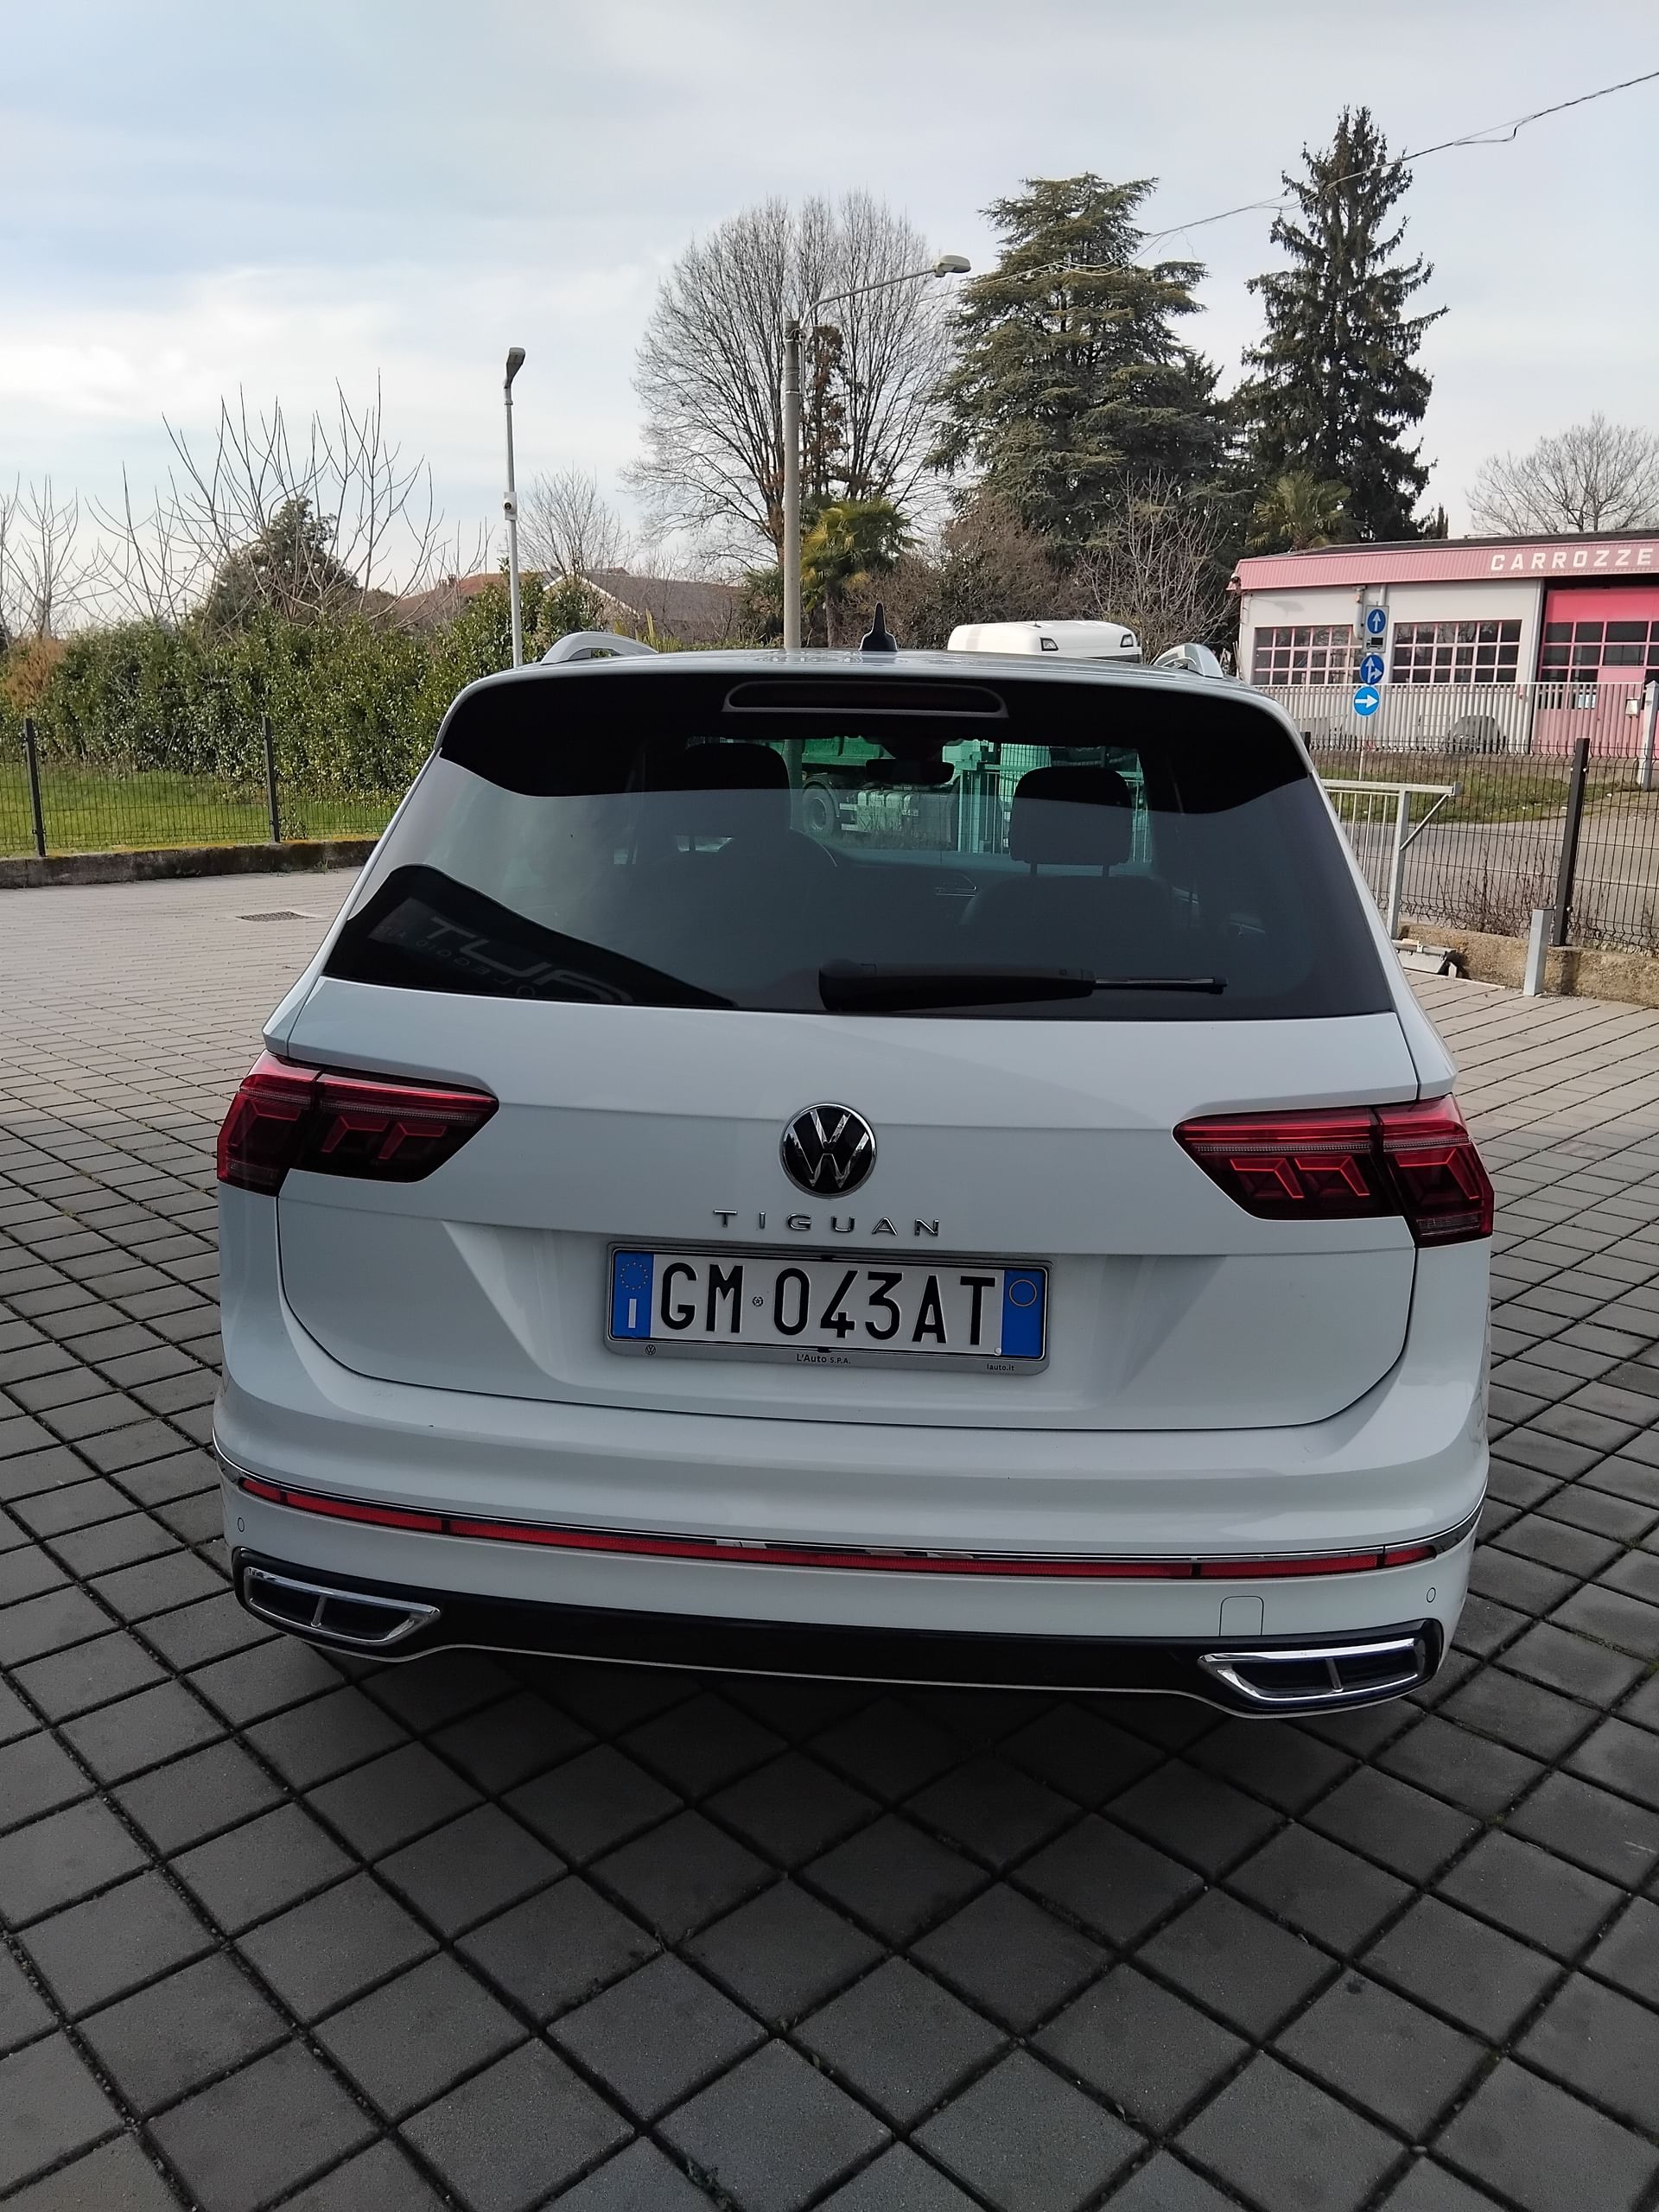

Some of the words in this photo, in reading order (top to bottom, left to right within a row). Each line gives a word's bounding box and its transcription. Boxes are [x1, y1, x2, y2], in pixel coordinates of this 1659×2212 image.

[1491, 548, 1654, 570] CARROZZE
[713, 1209, 939, 1236] TIGUAN
[796, 1353, 827, 1363] L'Auto
